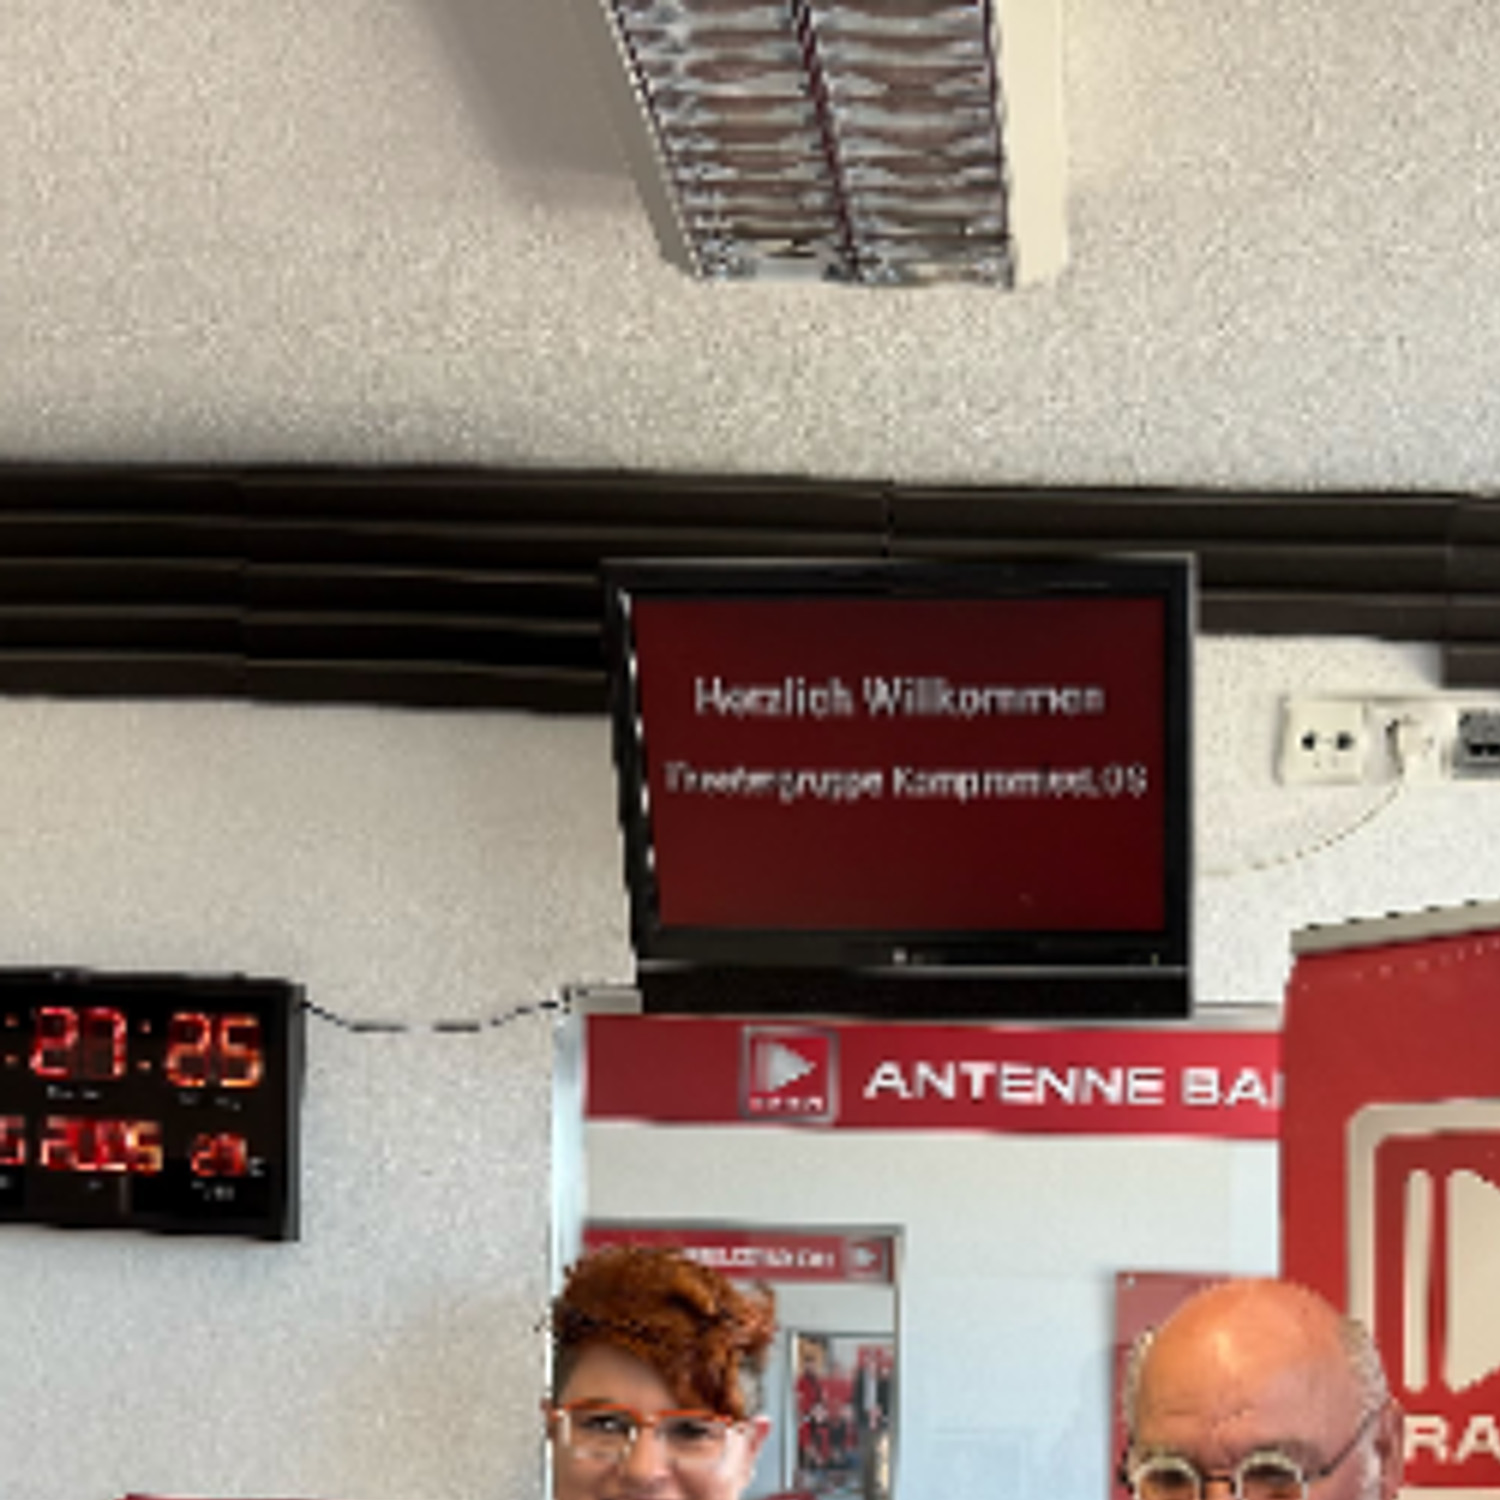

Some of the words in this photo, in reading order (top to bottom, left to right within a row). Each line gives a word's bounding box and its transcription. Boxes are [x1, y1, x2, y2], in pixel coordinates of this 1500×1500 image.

[695, 676, 854, 717] Herzlich
[863, 676, 1106, 718] Willkommen
[863, 1060, 1165, 1106] ANTENNE
[1180, 1066, 1283, 1110] BA
